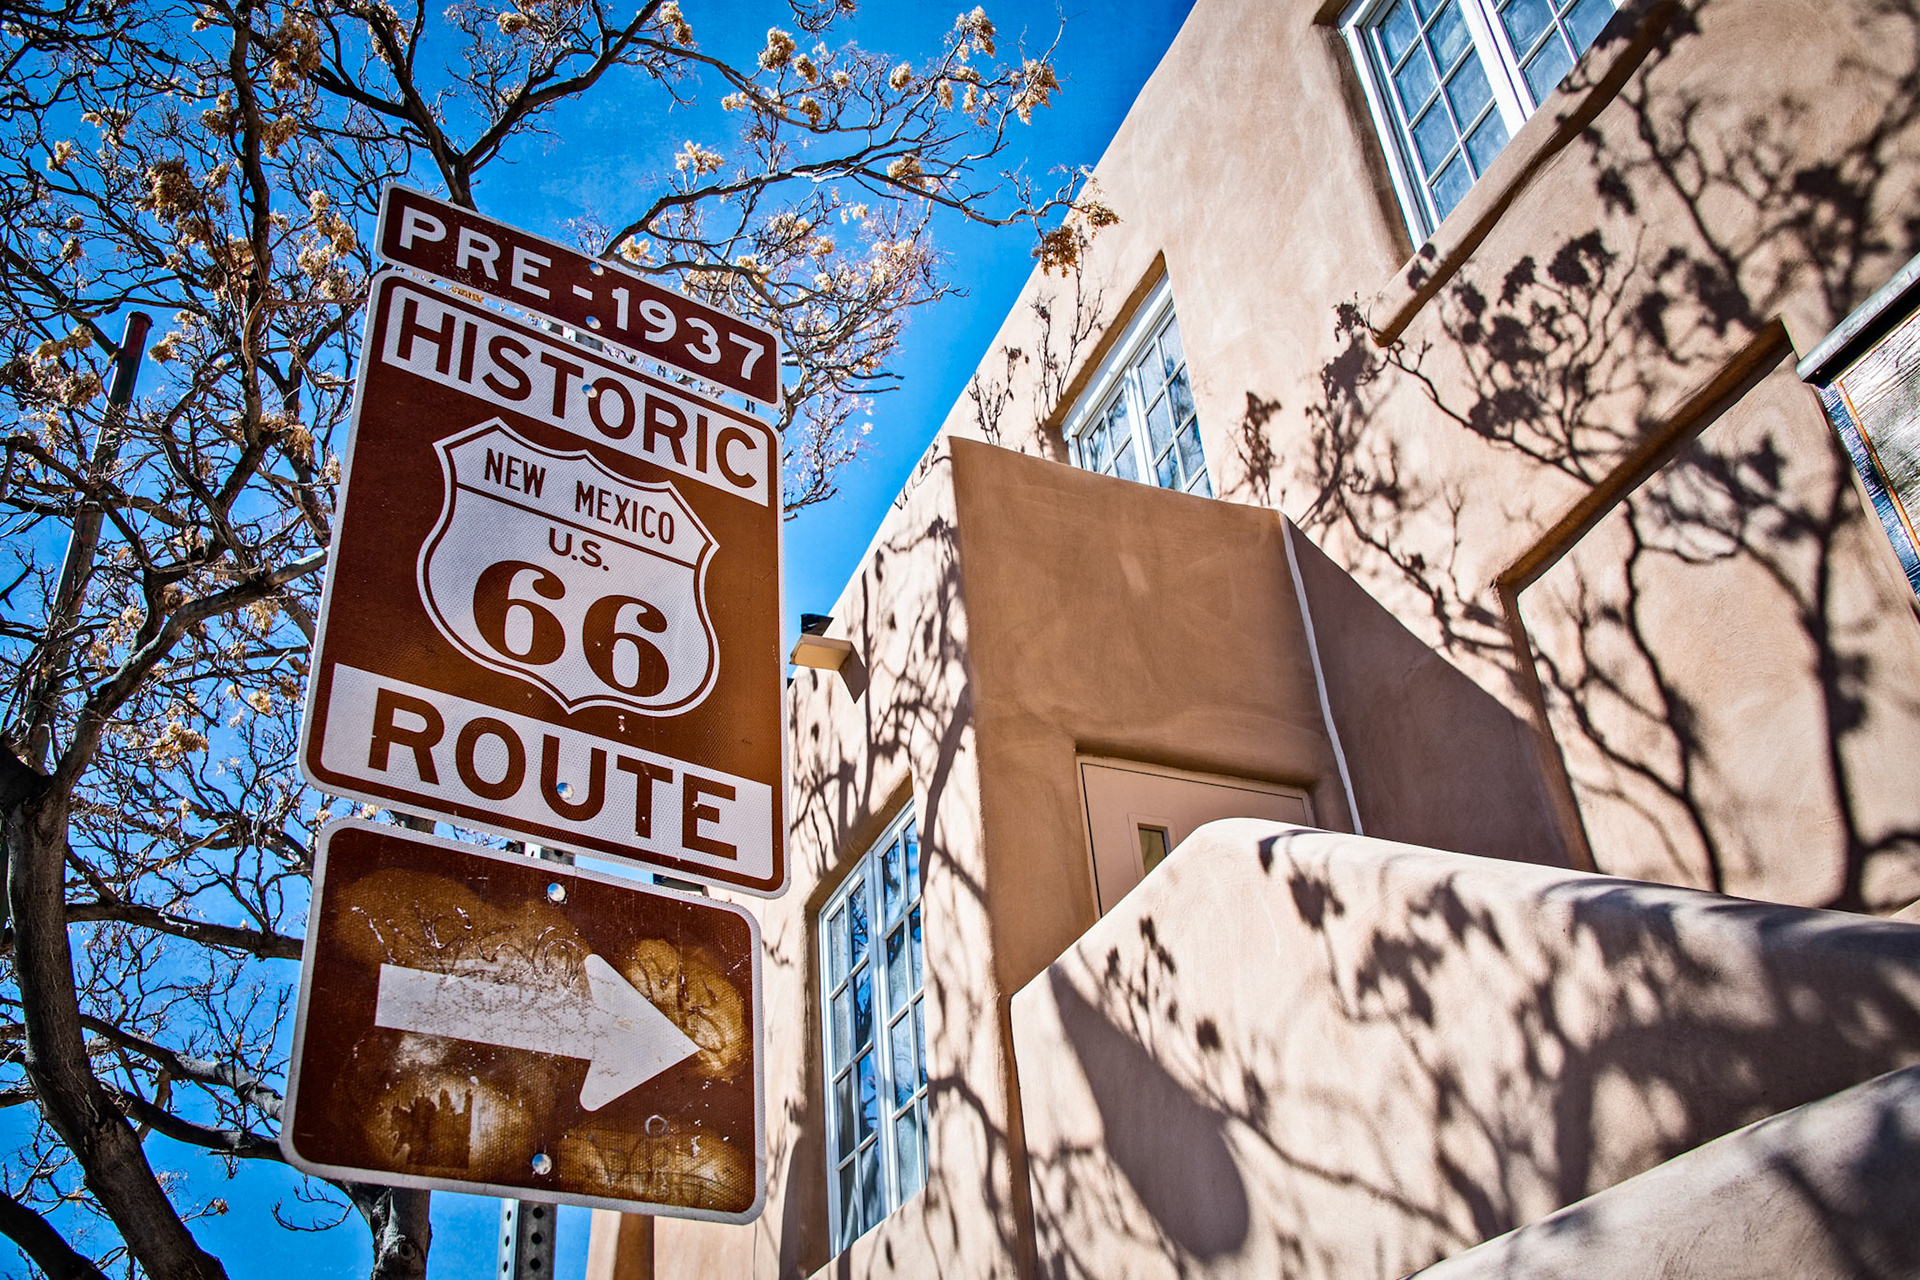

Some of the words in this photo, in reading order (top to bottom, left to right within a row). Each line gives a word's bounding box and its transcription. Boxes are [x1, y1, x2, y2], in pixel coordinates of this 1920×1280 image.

[396, 297, 758, 489] HISTORIC
[484, 448, 547, 498] NEW
[575, 480, 674, 545] MEXICO
[549, 528, 610, 571] U.S.
[473, 560, 670, 698] 66
[368, 688, 738, 861] ROUTE
